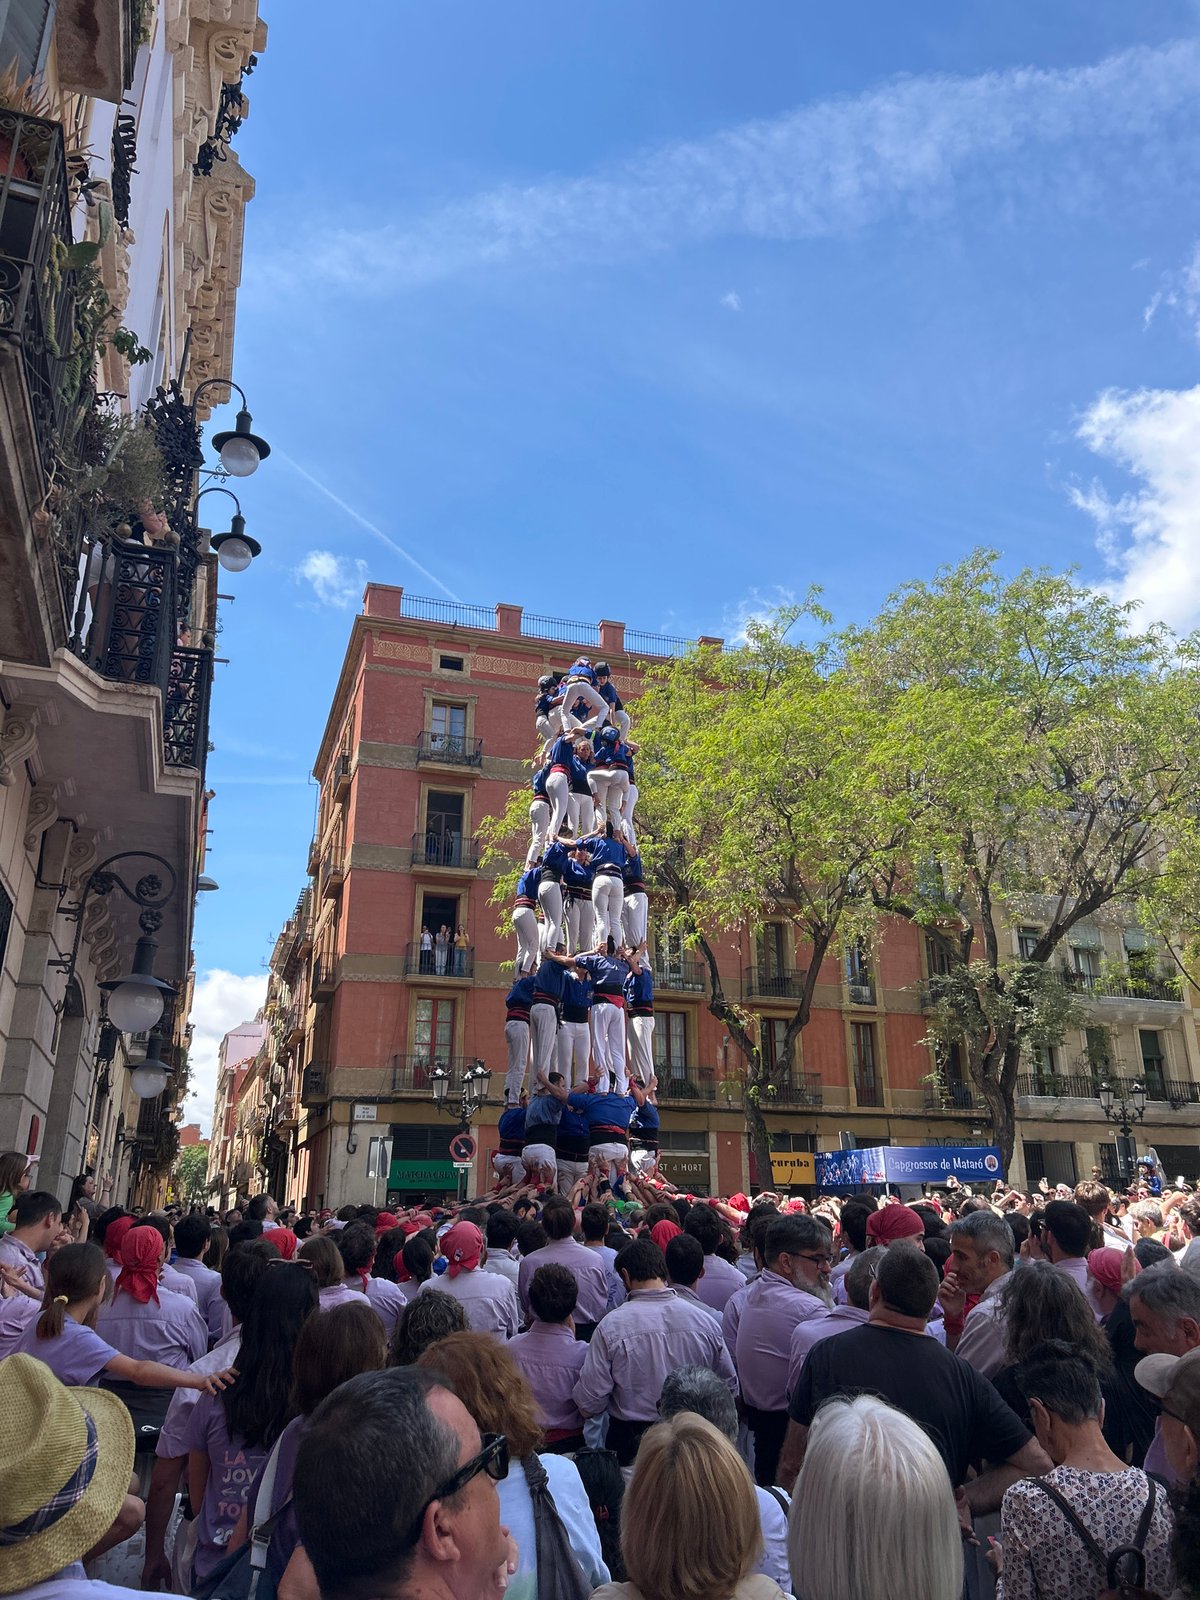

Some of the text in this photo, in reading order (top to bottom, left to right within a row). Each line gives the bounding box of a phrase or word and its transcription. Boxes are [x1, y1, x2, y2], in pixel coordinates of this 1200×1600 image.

[681, 1163, 703, 1171] HORT
[771, 1158, 810, 1168] curuba
[888, 1157, 984, 1172] Capgrossos de Mataró
[224, 1450, 247, 1465] LA
